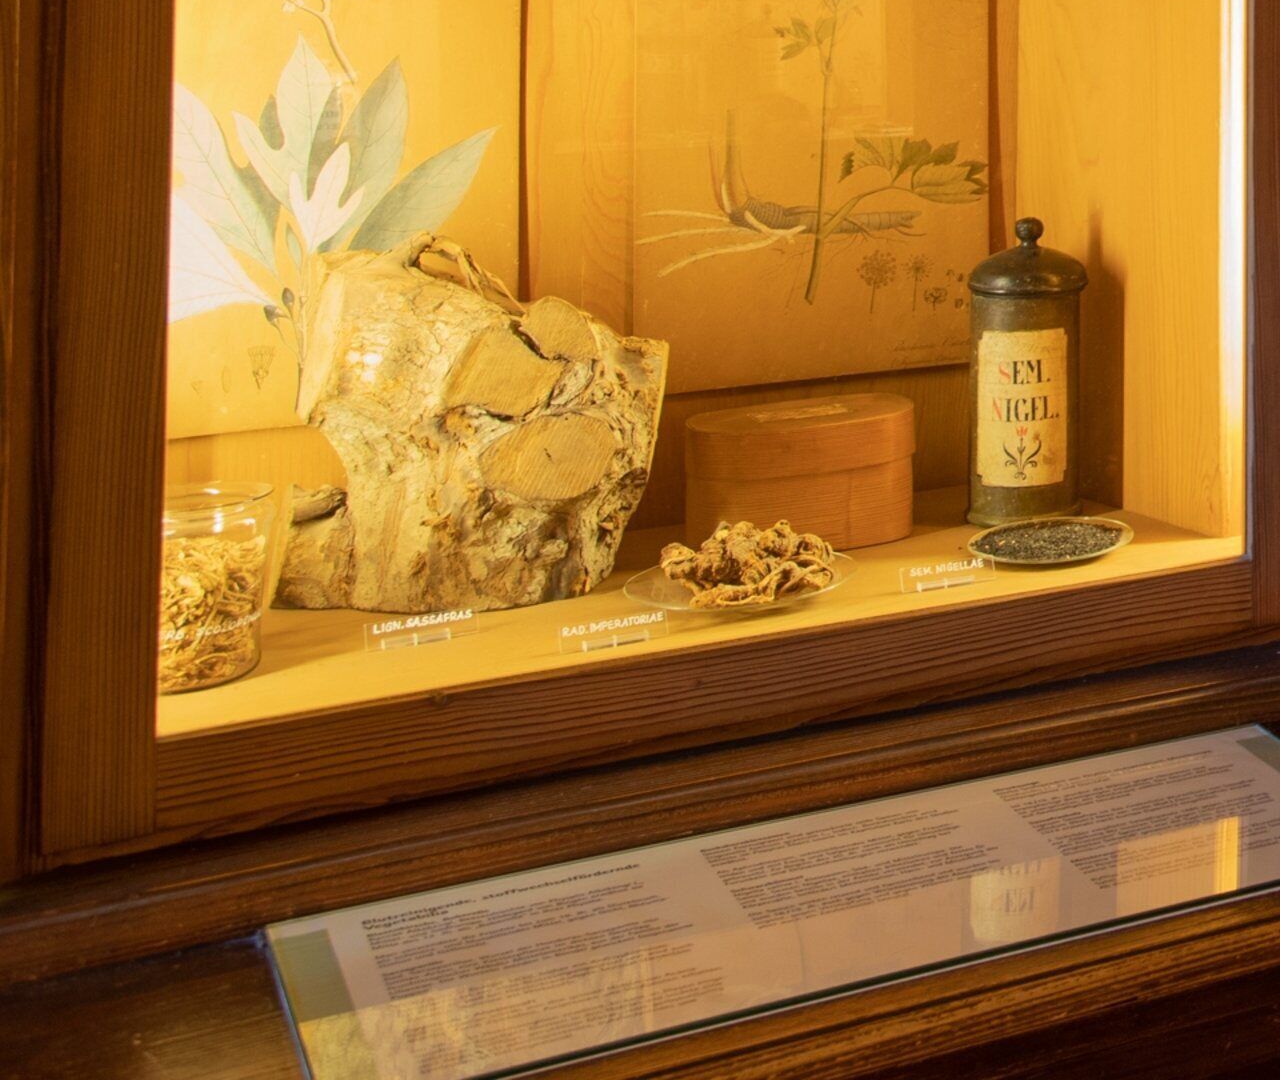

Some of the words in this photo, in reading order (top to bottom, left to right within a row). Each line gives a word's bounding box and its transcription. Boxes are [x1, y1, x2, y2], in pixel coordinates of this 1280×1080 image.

[998, 358, 1052, 387] SEM.
[991, 395, 1061, 423] NIGEL.
[909, 566, 933, 578] SEM.
[935, 558, 985, 575] NIGELLAE
[371, 622, 406, 635] LIGN.
[406, 608, 474, 630] SASSAFRAS
[562, 624, 590, 639] RAD.
[590, 610, 667, 634] IMPERATORIAE
[481, 862, 642, 901] stoffwechselfördernde
